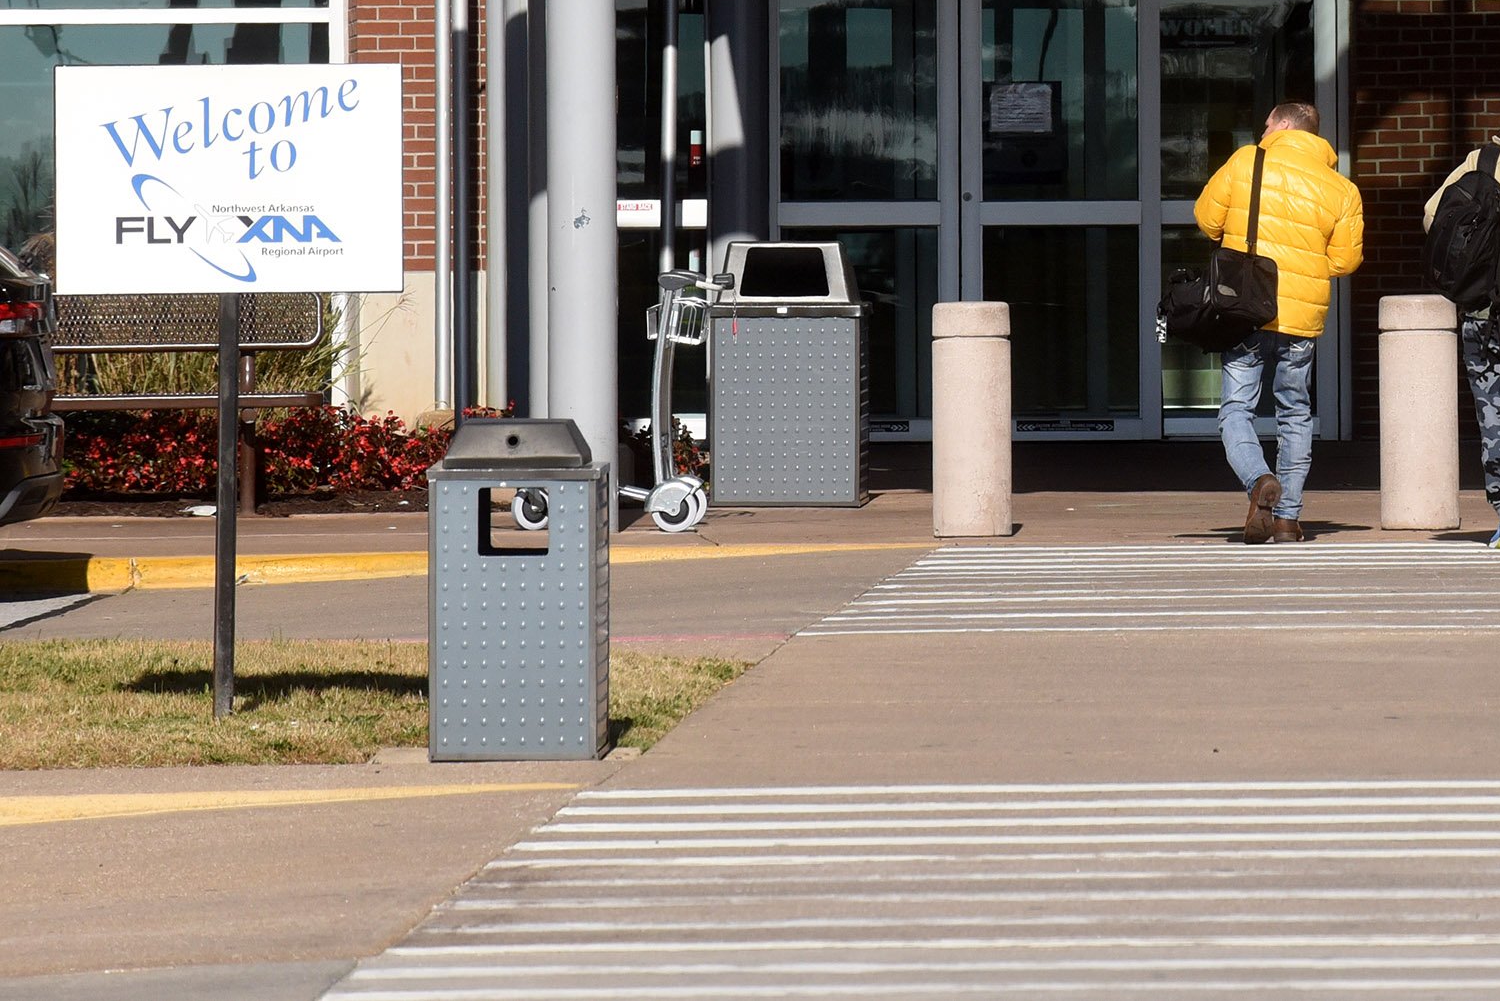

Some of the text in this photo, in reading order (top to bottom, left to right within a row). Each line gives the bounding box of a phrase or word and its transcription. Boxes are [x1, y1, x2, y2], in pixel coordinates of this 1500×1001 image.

[98, 79, 360, 168] Welcome
[242, 140, 297, 180] to
[212, 203, 315, 213] Northwest Arkansas
[116, 215, 342, 244] FLY XNA
[261, 246, 344, 258] Regional Airport
